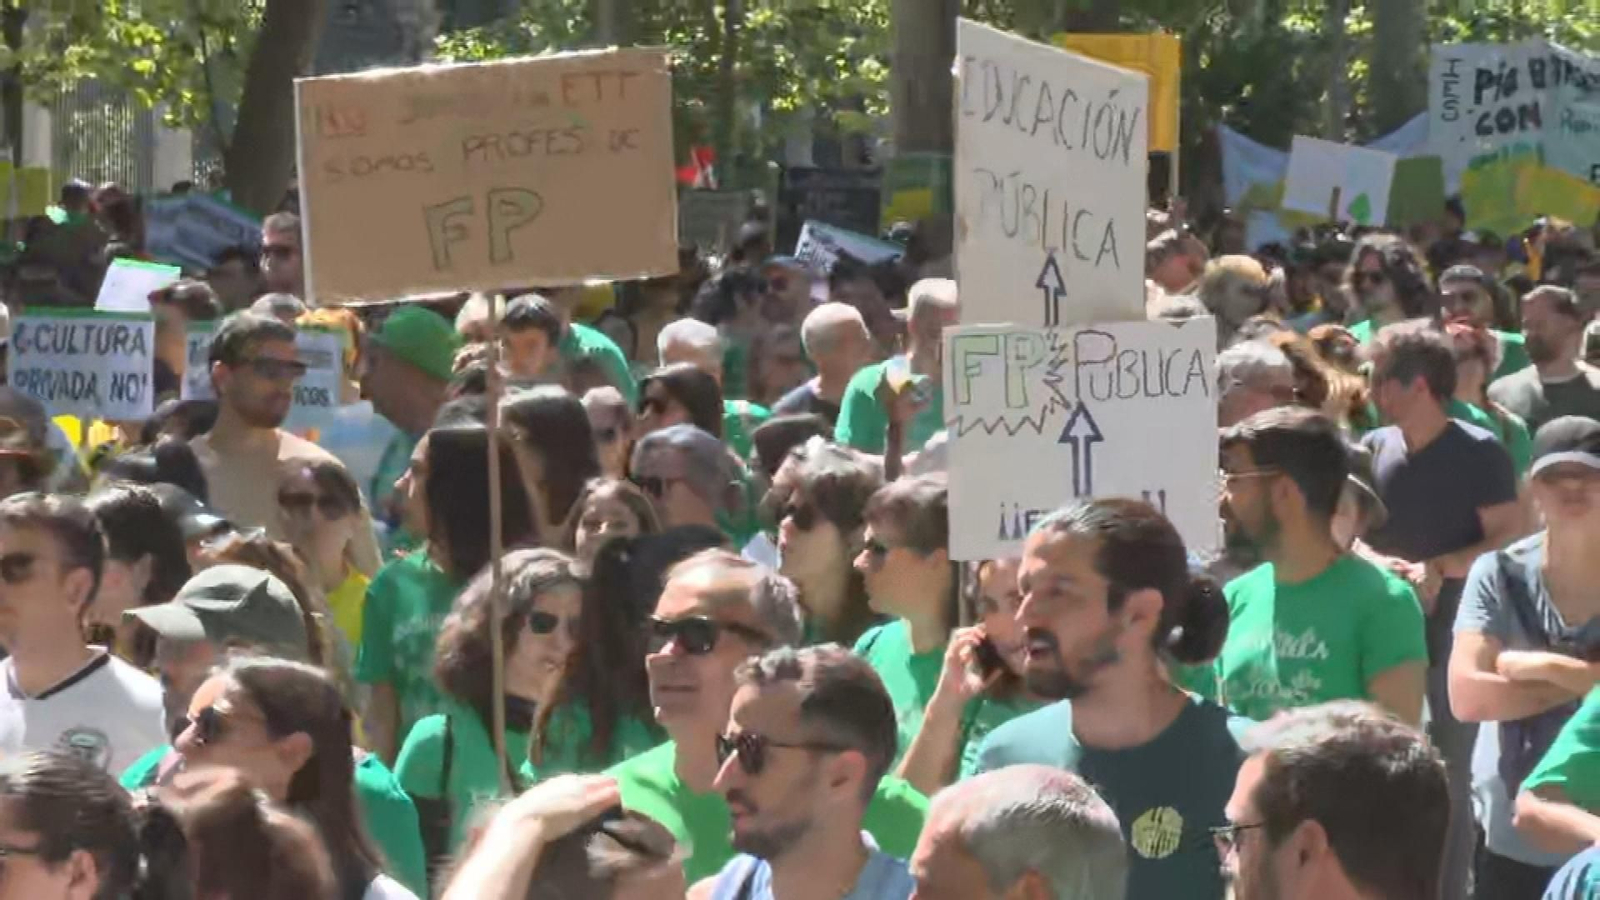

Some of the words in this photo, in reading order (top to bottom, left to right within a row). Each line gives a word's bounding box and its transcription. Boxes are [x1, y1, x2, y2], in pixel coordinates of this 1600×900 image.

[561, 70, 638, 107] ETT
[962, 56, 1142, 166] EDUCACIÓN
[1475, 101, 1541, 135] CON
[323, 151, 434, 184] SOMOS
[461, 126, 587, 163] PROFES
[423, 187, 544, 271] FP
[974, 168, 1120, 268] PÚBLICA
[953, 334, 1047, 409] FP
